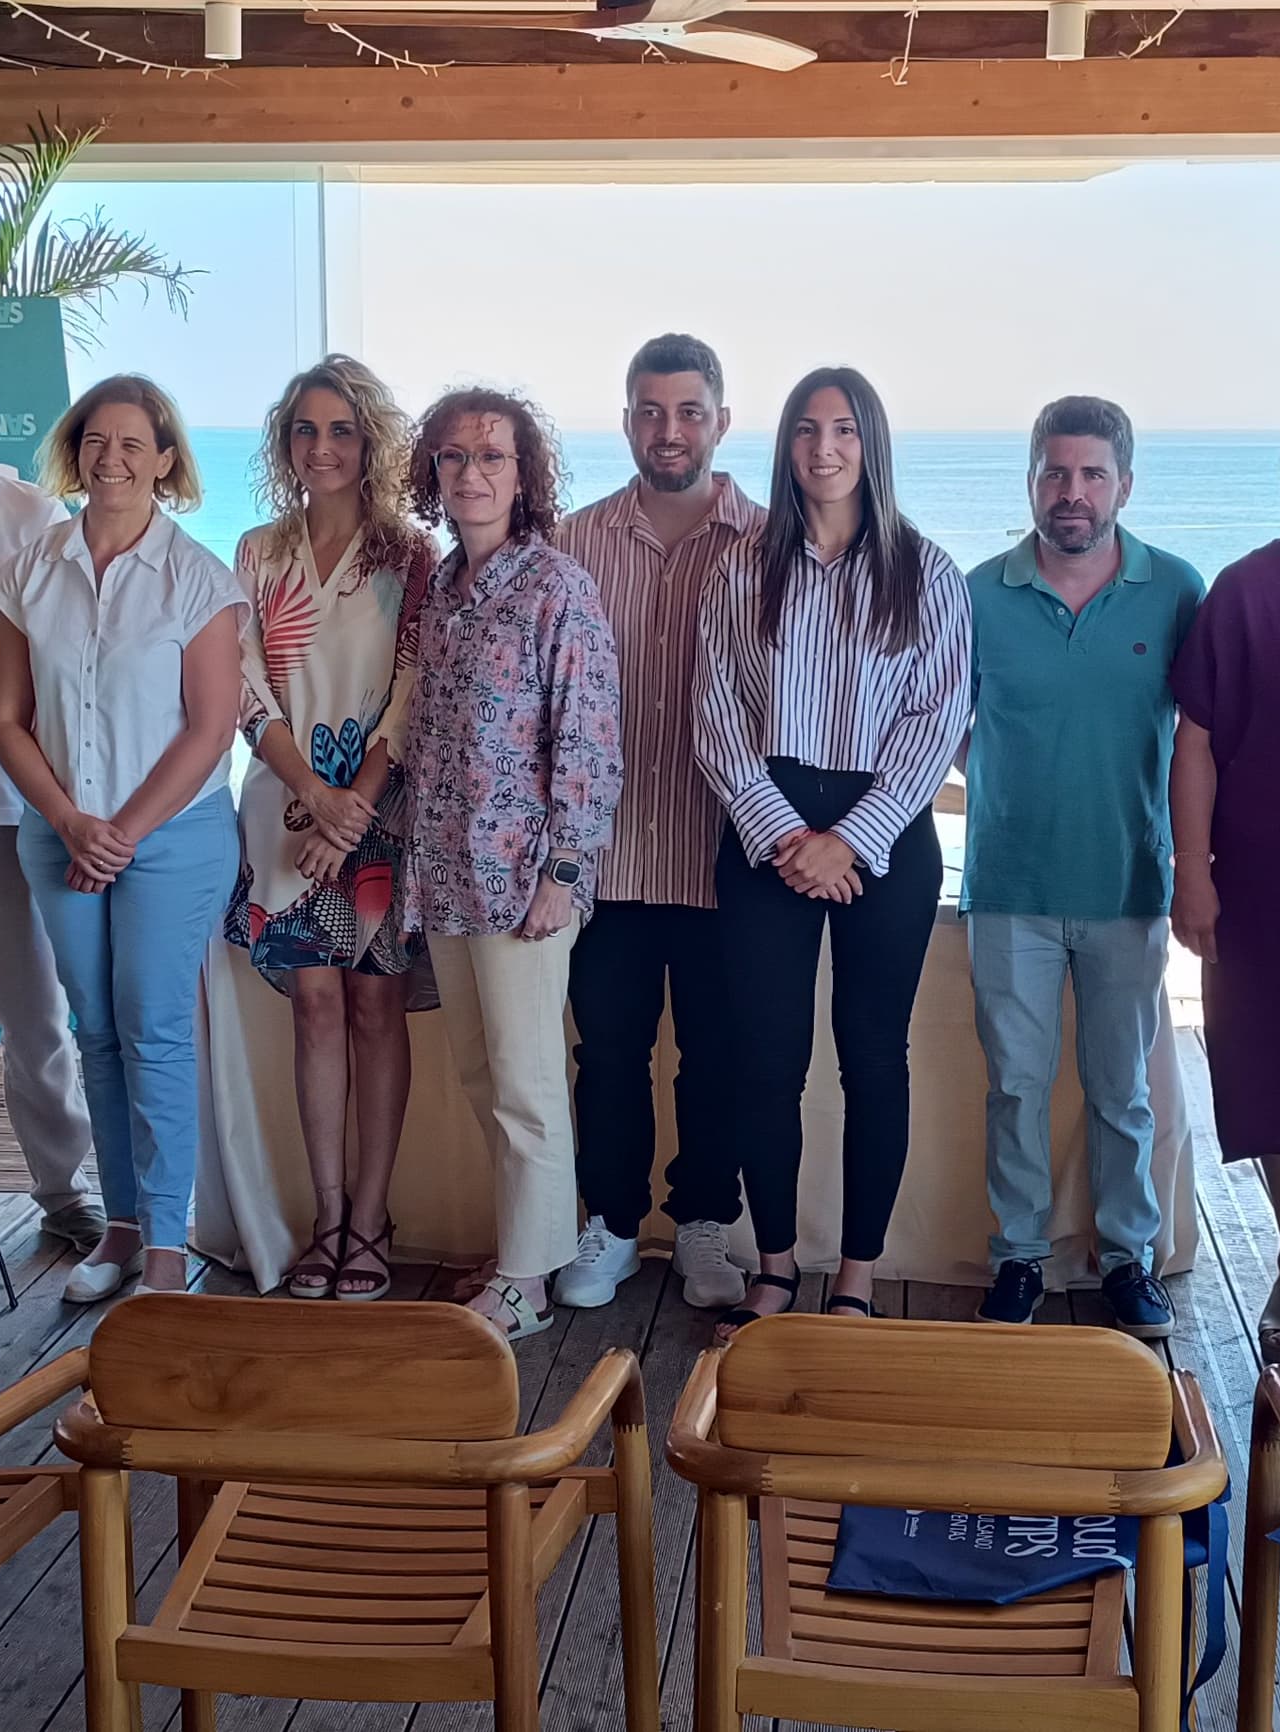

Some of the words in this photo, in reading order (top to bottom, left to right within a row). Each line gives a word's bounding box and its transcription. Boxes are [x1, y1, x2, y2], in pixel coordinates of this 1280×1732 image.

[948, 1512, 968, 1541] ENTAS
[974, 1514, 996, 1550] ULSANDO
[1004, 1516, 1059, 1558] TIPS
[1072, 1515, 1133, 1569] oud
